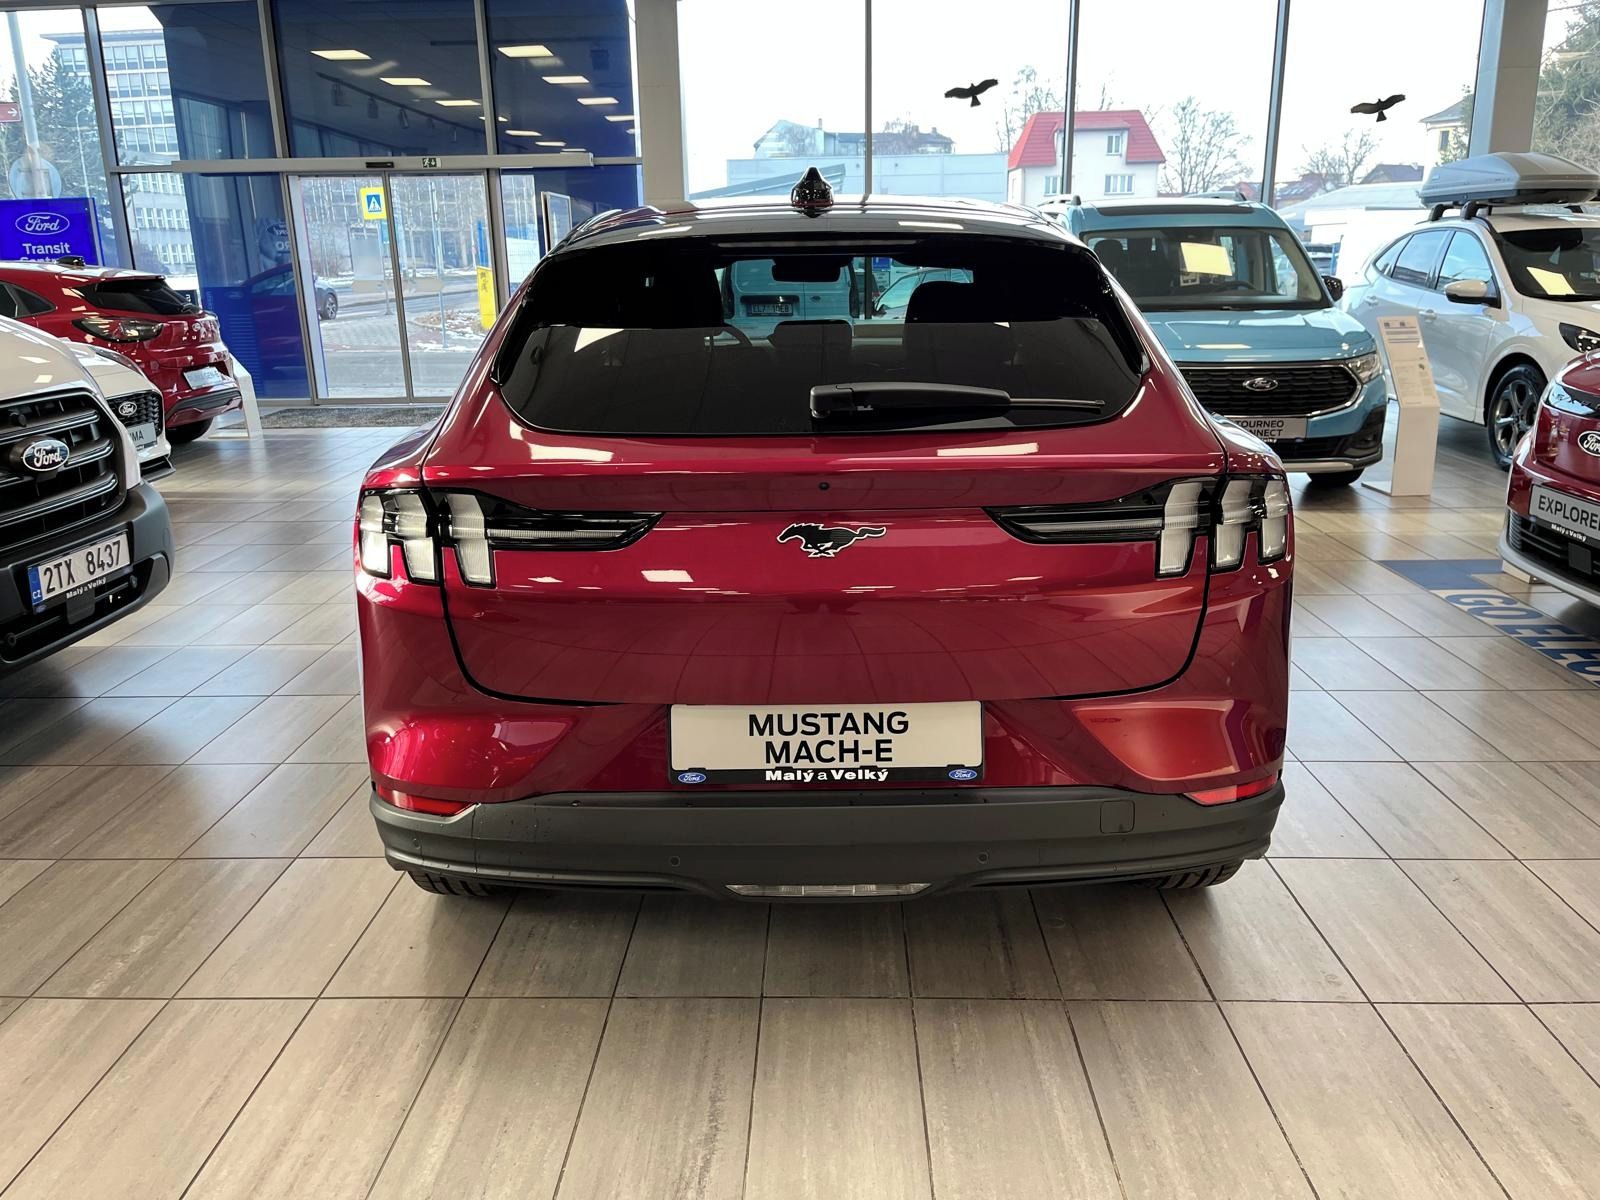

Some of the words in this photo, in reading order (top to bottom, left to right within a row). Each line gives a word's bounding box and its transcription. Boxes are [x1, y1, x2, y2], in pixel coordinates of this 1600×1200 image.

[25, 215, 60, 231] Ford
[22, 242, 71, 255] Transit
[1235, 420, 1284, 428] TOURNEO
[130, 429, 145, 441] MA
[1249, 429, 1284, 437] NNECT
[33, 445, 63, 468] Ford
[1538, 494, 1600, 532] EXPLORE
[43, 558, 76, 594] 2TX
[86, 539, 121, 576] 8437
[32, 589, 42, 599] CZ
[66, 586, 83, 599] Malý
[88, 577, 107, 589] Velký
[748, 711, 909, 737] MUSTANG
[765, 738, 893, 764] MACH-E
[765, 770, 814, 783] Malý
[817, 773, 828, 781] a
[831, 768, 889, 782] Velký
